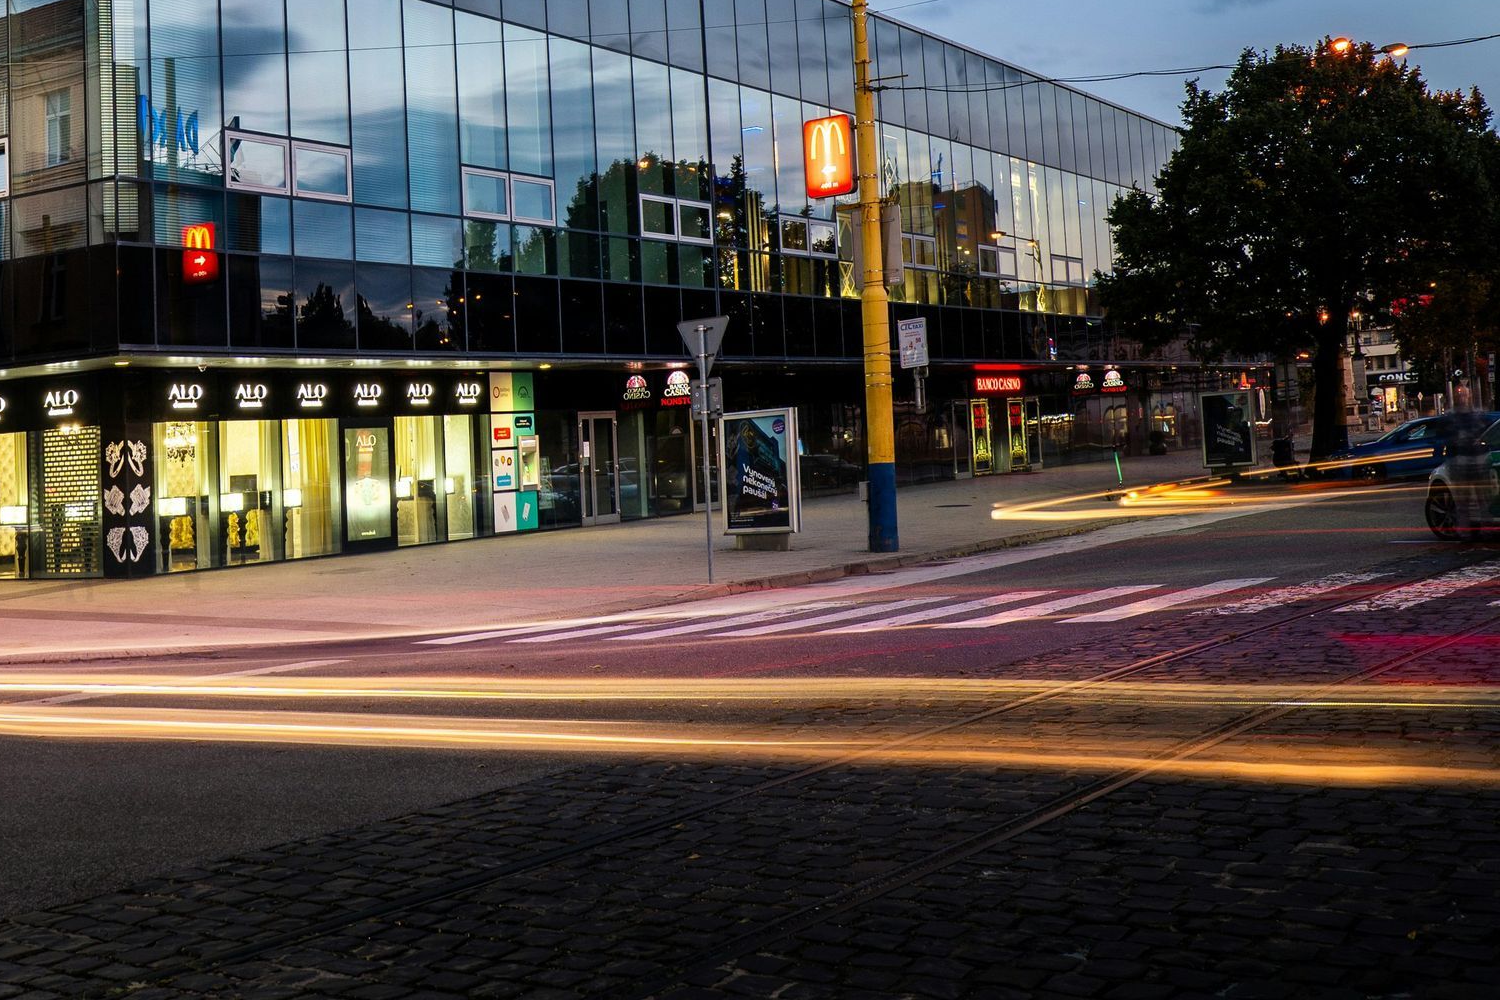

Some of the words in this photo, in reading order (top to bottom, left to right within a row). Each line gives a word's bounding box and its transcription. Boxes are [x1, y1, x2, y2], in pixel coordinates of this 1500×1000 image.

[235, 383, 267, 400] ALO
[297, 383, 327, 399] ALO
[354, 383, 382, 398] ALO
[407, 383, 433, 398] ALO
[455, 383, 481, 397] ALO
[977, 378, 998, 390] BANCO
[998, 378, 1020, 390] CASINO
[44, 389, 78, 408] ALO
[168, 384, 203, 400] ALO
[661, 396, 691, 407] NONSTO
[356, 434, 376, 447] ALO
[742, 463, 775, 487] Vynovený
[742, 475, 777, 496] nekonečný
[742, 485, 767, 499] paušál
